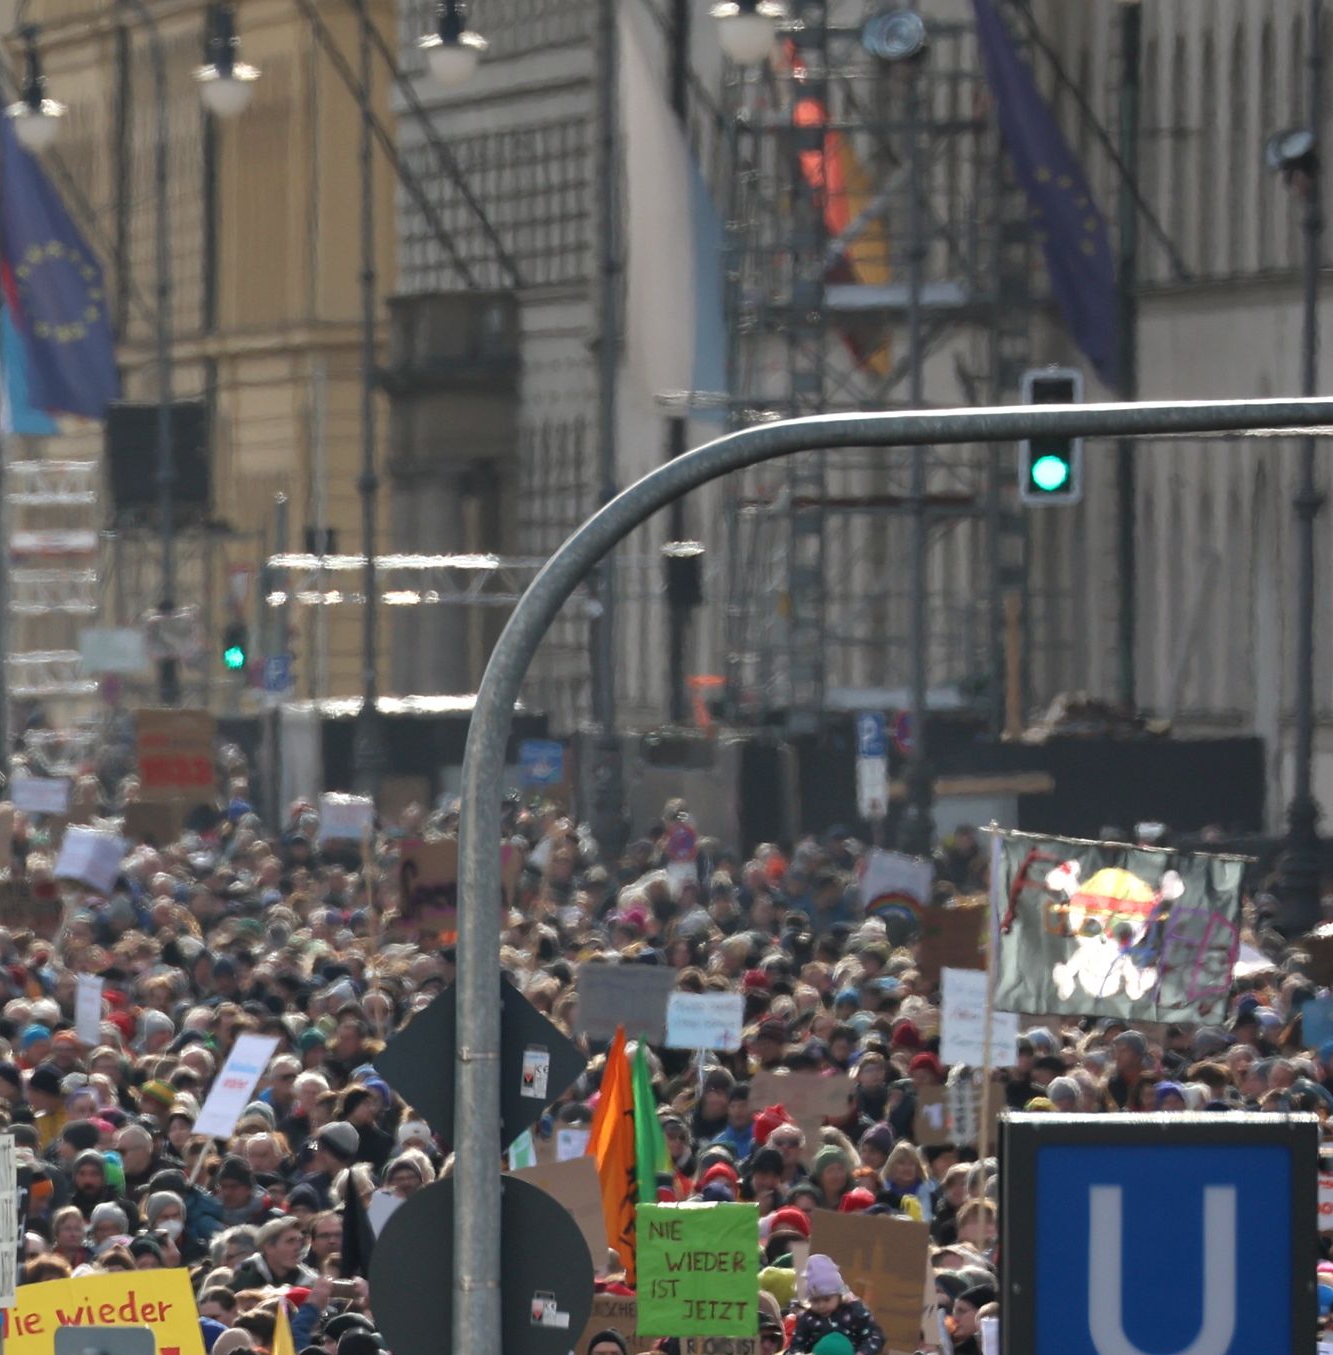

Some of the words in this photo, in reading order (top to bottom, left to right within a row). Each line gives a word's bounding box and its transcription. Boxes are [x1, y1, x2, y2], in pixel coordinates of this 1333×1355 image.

[648, 1219, 682, 1241] NIE
[665, 1251, 747, 1273] WIEDER
[651, 1279, 680, 1299] IST
[56, 1290, 173, 1326] wieder
[684, 1300, 748, 1321] JETZT
